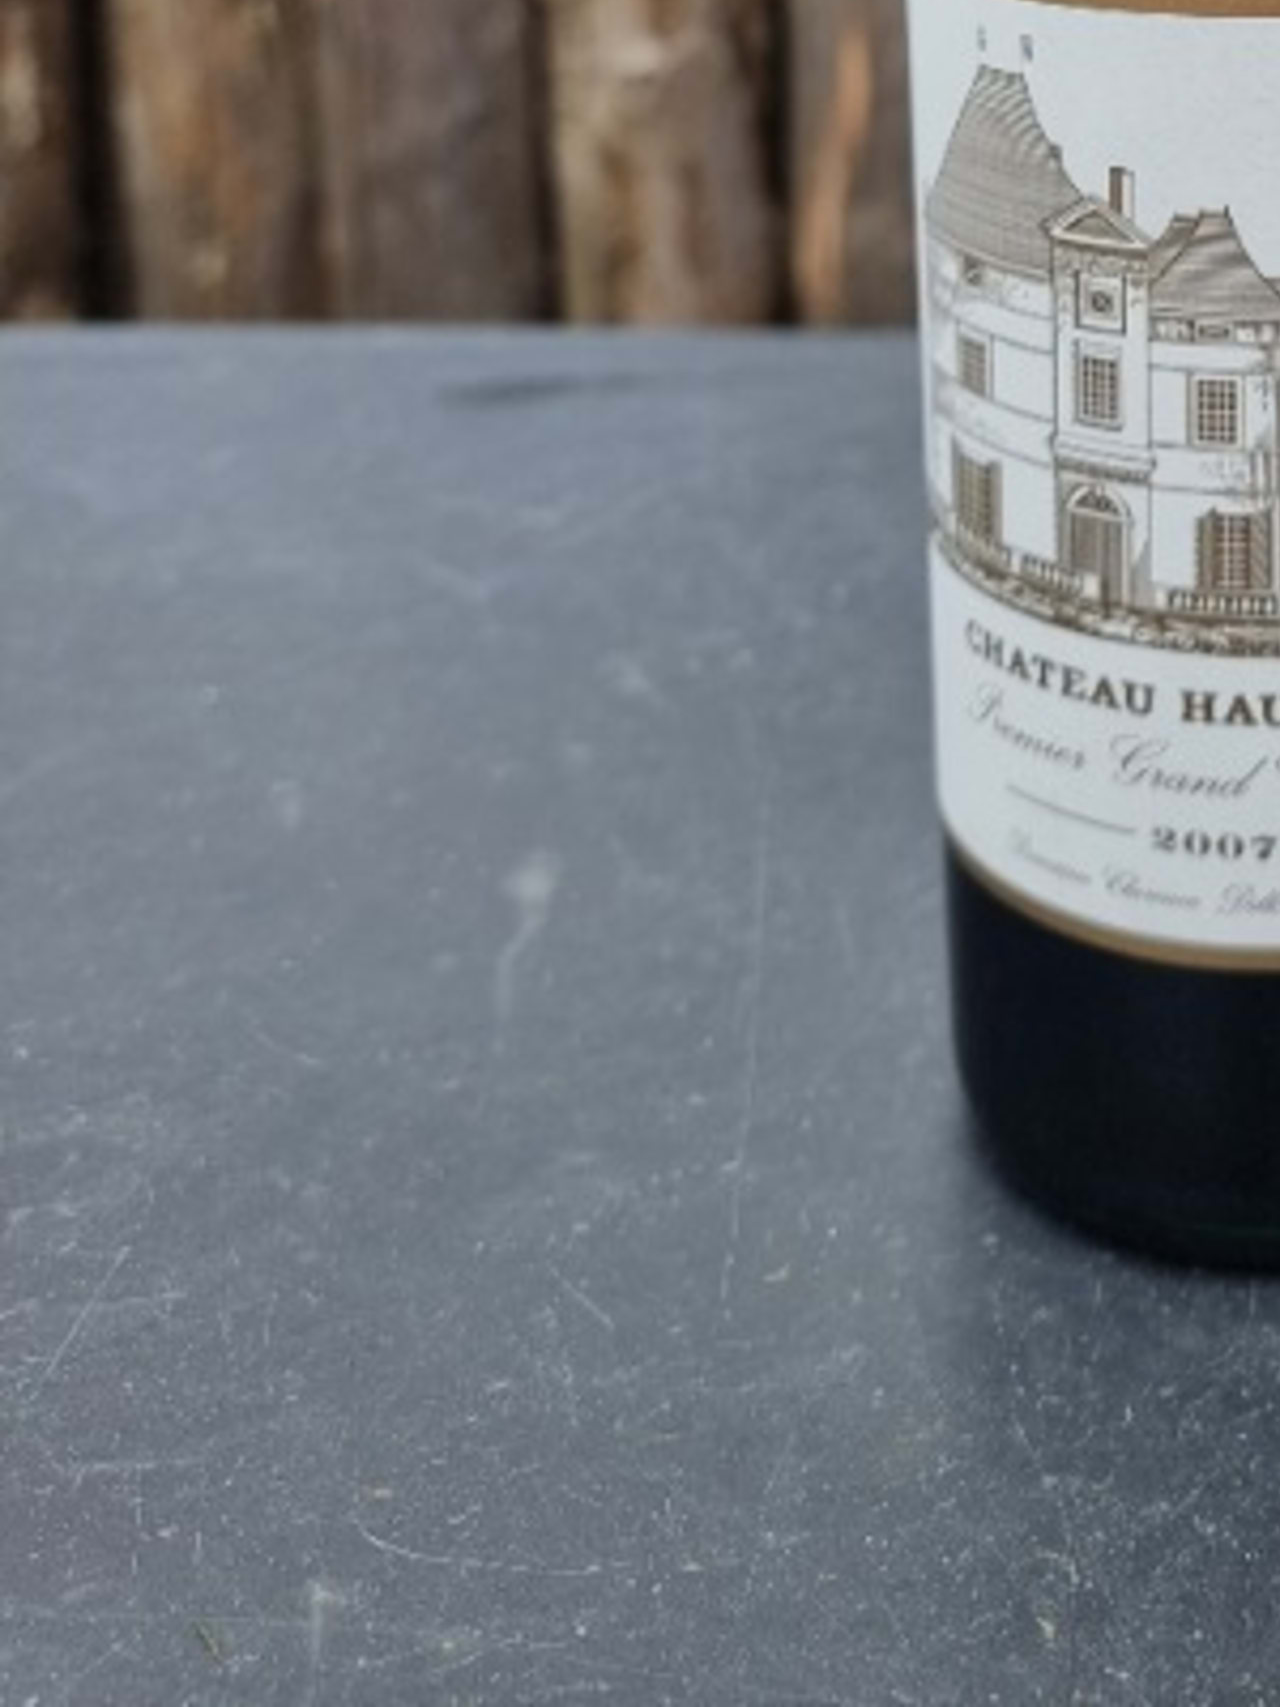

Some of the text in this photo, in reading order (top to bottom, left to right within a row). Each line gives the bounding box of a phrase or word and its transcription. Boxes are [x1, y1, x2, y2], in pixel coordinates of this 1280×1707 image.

[964, 618, 1156, 718] CHATEAU
[1108, 732, 1269, 799] Grand
[1151, 825, 1278, 862] 2007
